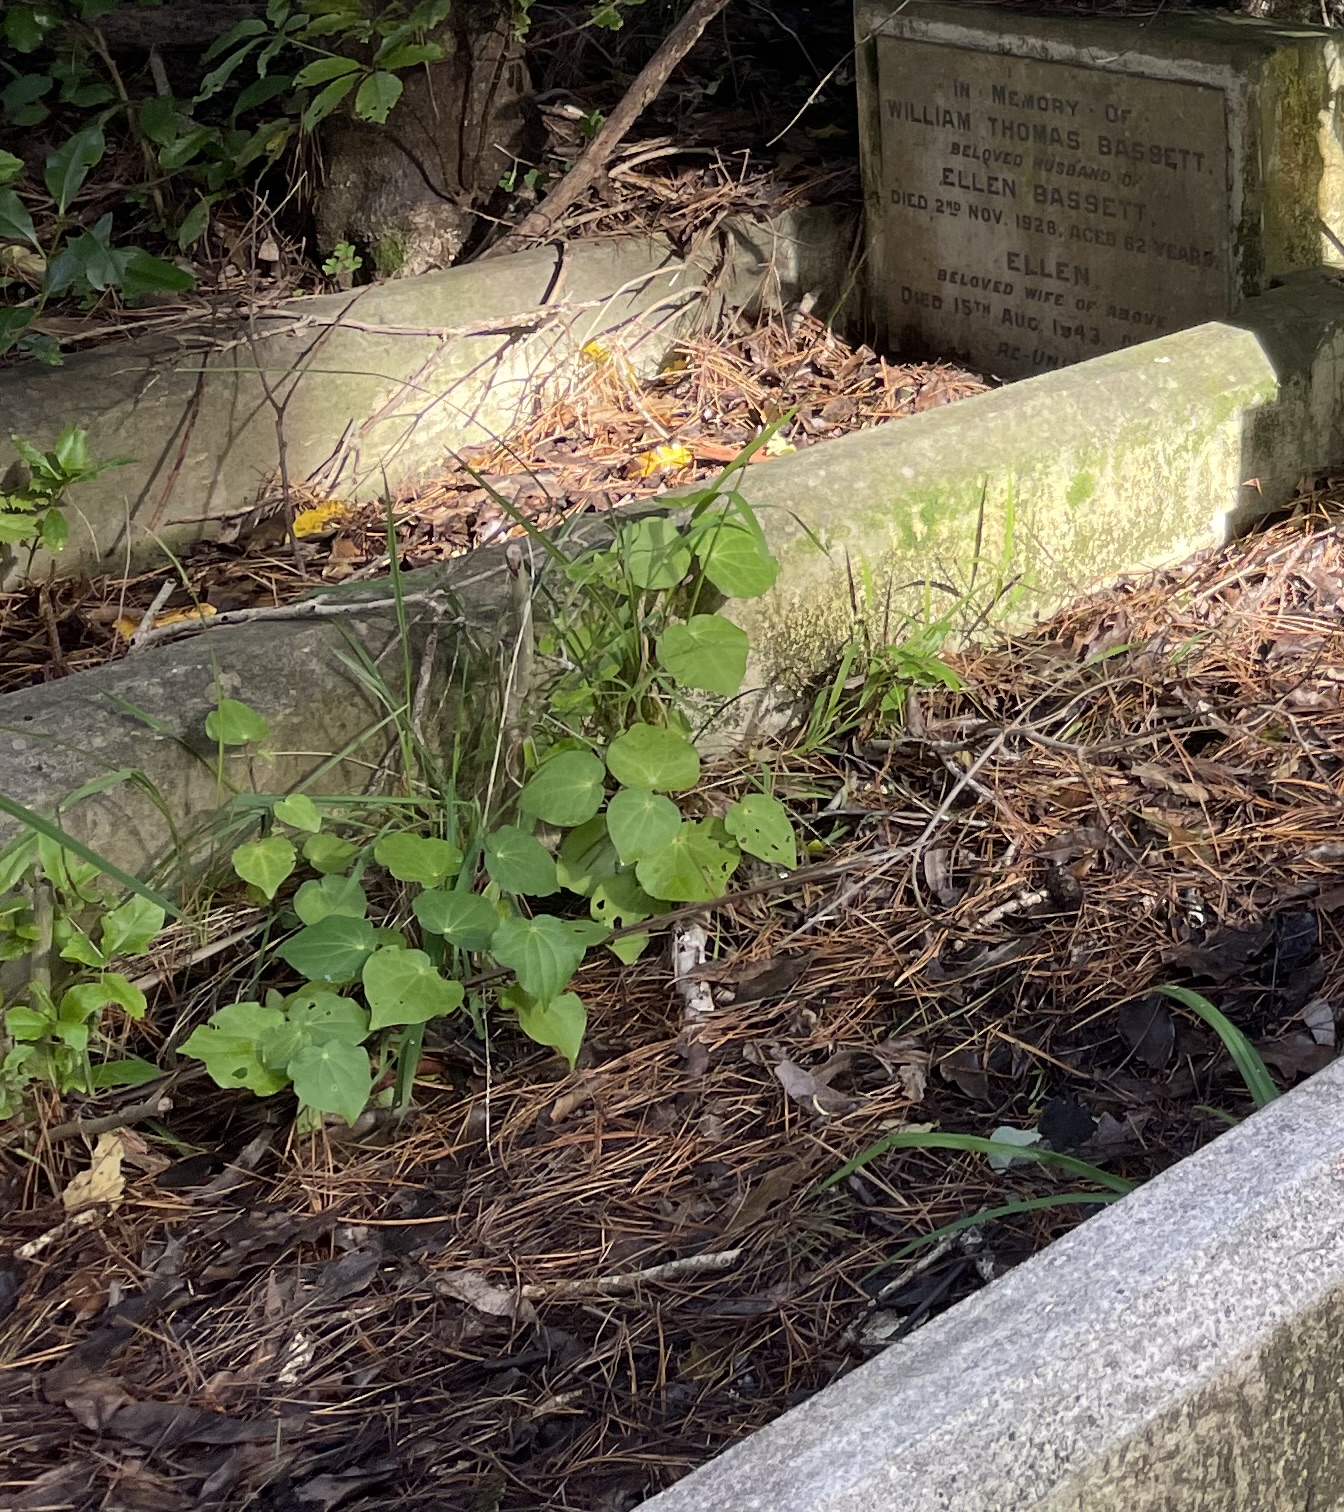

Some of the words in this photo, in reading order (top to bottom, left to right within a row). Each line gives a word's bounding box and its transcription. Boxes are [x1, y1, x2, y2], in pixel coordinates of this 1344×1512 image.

[886, 98, 972, 132] WILLIAM
[986, 115, 1081, 152] THOMAS
[953, 78, 971, 100] IN
[991, 83, 1080, 117] MEMORY
[1105, 103, 1133, 125] OF
[939, 167, 1017, 199] ELLEN
[950, 140, 1024, 168] BELOVED
[1032, 154, 1112, 185] HUSBAND
[1121, 172, 1142, 190] OF
[890, 188, 929, 211] DIED
[968, 205, 1009, 228] NOV.
[1069, 224, 1117, 248] AGED
[1123, 234, 1147, 254] 62
[901, 285, 943, 310] DIED
[953, 296, 992, 317] 15TH
[937, 268, 1014, 296] BELOVED
[1024, 285, 1065, 307] WIFE
[1075, 297, 1098, 313] OF
[1105, 304, 1168, 329] ABOVE
